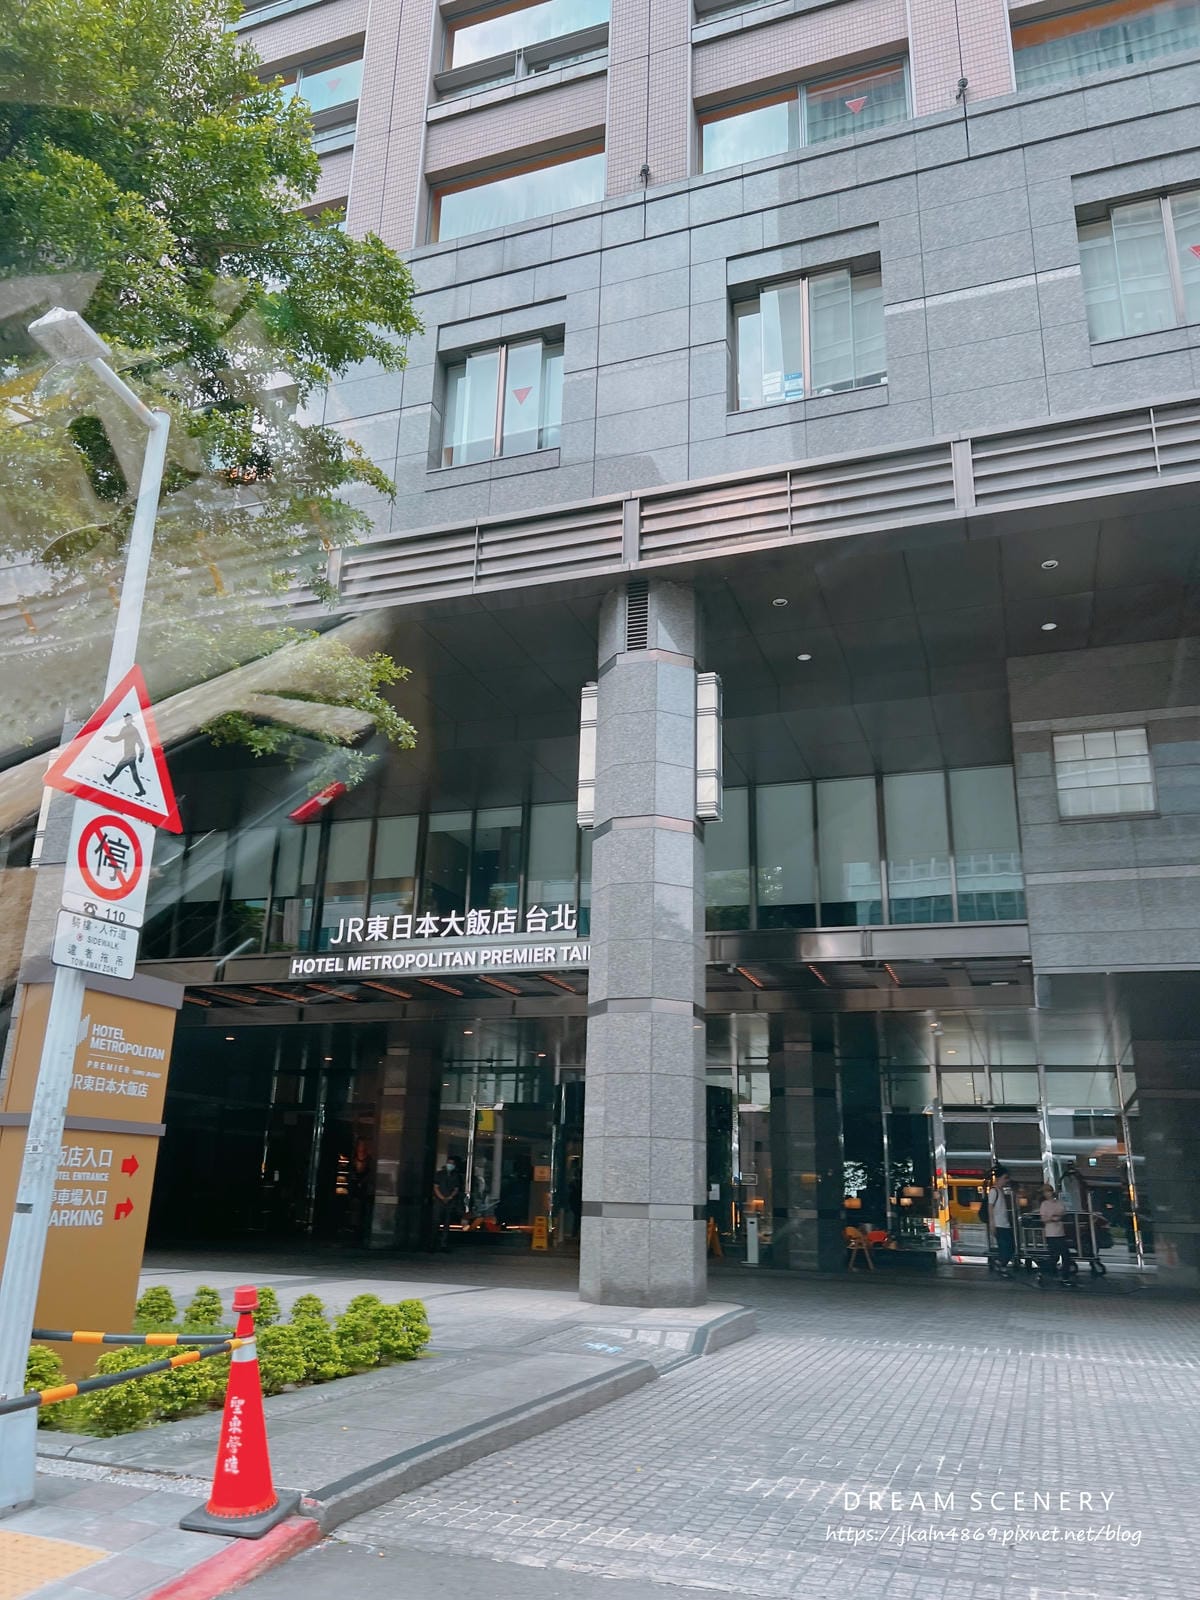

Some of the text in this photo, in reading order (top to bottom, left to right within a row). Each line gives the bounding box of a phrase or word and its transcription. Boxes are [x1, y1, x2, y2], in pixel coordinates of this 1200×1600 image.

[94, 833, 130, 881] 停
[105, 908, 126, 923] 110
[330, 903, 577, 944] JR東日本大飯店 台北
[87, 935, 120, 950] SIDEWALK
[291, 944, 591, 974] HOTEL METROPOLITAN PREMIER TAI
[92, 1023, 125, 1041] HOTEL
[90, 1036, 165, 1061] METROPOLITAN
[86, 1060, 130, 1074] PREMIER
[72, 1073, 149, 1098] R東日本大飯店
[72, 1172, 109, 1182] ENTRANCE
[48, 1209, 104, 1227] ARKING
